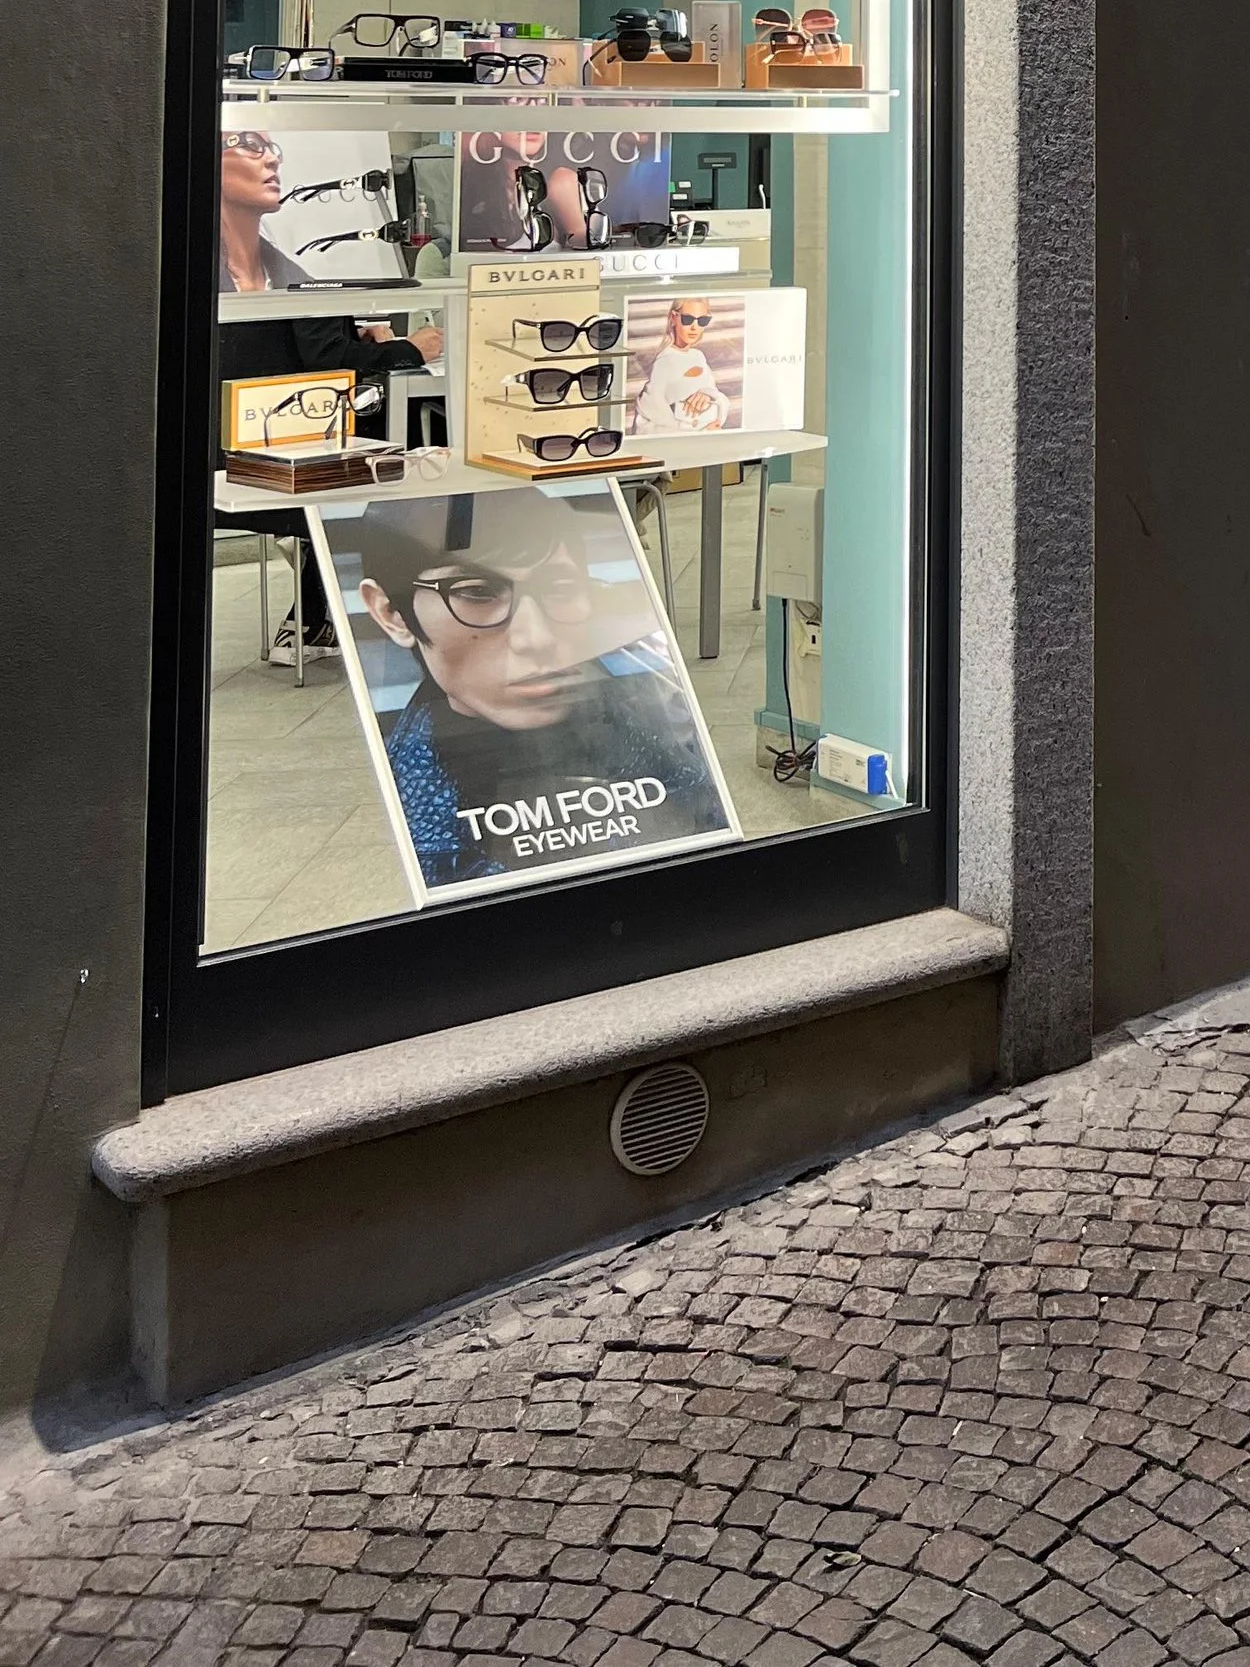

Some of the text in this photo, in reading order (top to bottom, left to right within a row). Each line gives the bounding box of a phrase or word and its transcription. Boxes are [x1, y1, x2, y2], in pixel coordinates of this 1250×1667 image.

[709, 23, 719, 63] OLON
[469, 131, 662, 164] GUCCI
[489, 268, 585, 283] BVLGARI
[245, 400, 342, 421] BVLGAR
[456, 777, 668, 841] TOM FORD
[512, 815, 641, 857] EYEWEAR
